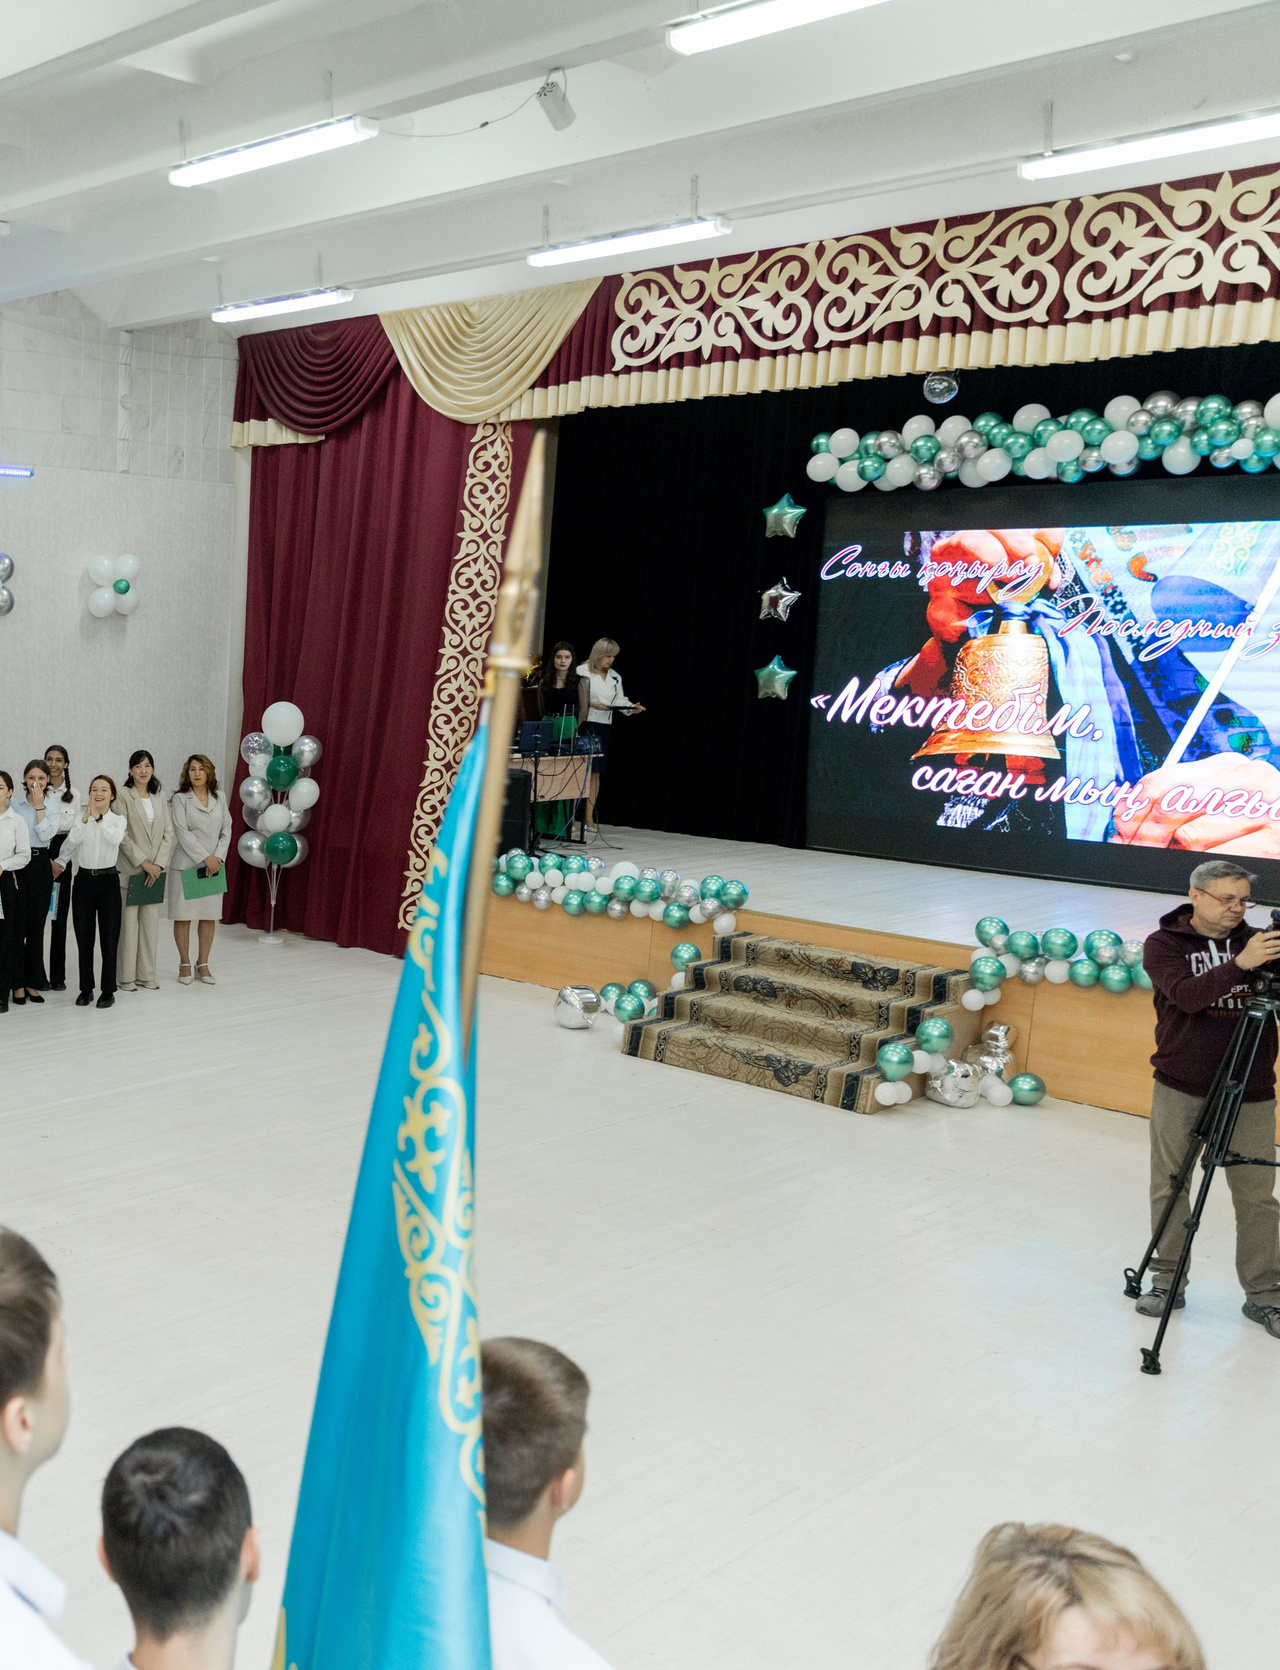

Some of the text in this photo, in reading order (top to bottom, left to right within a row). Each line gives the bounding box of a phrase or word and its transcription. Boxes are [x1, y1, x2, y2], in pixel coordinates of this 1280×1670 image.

[917, 558, 1044, 600] қоңырау
[1056, 593, 1254, 662] Последний
[810, 676, 1104, 742] «Мектебім,
[911, 765, 1029, 800] саған
[1034, 776, 1150, 823] мың
